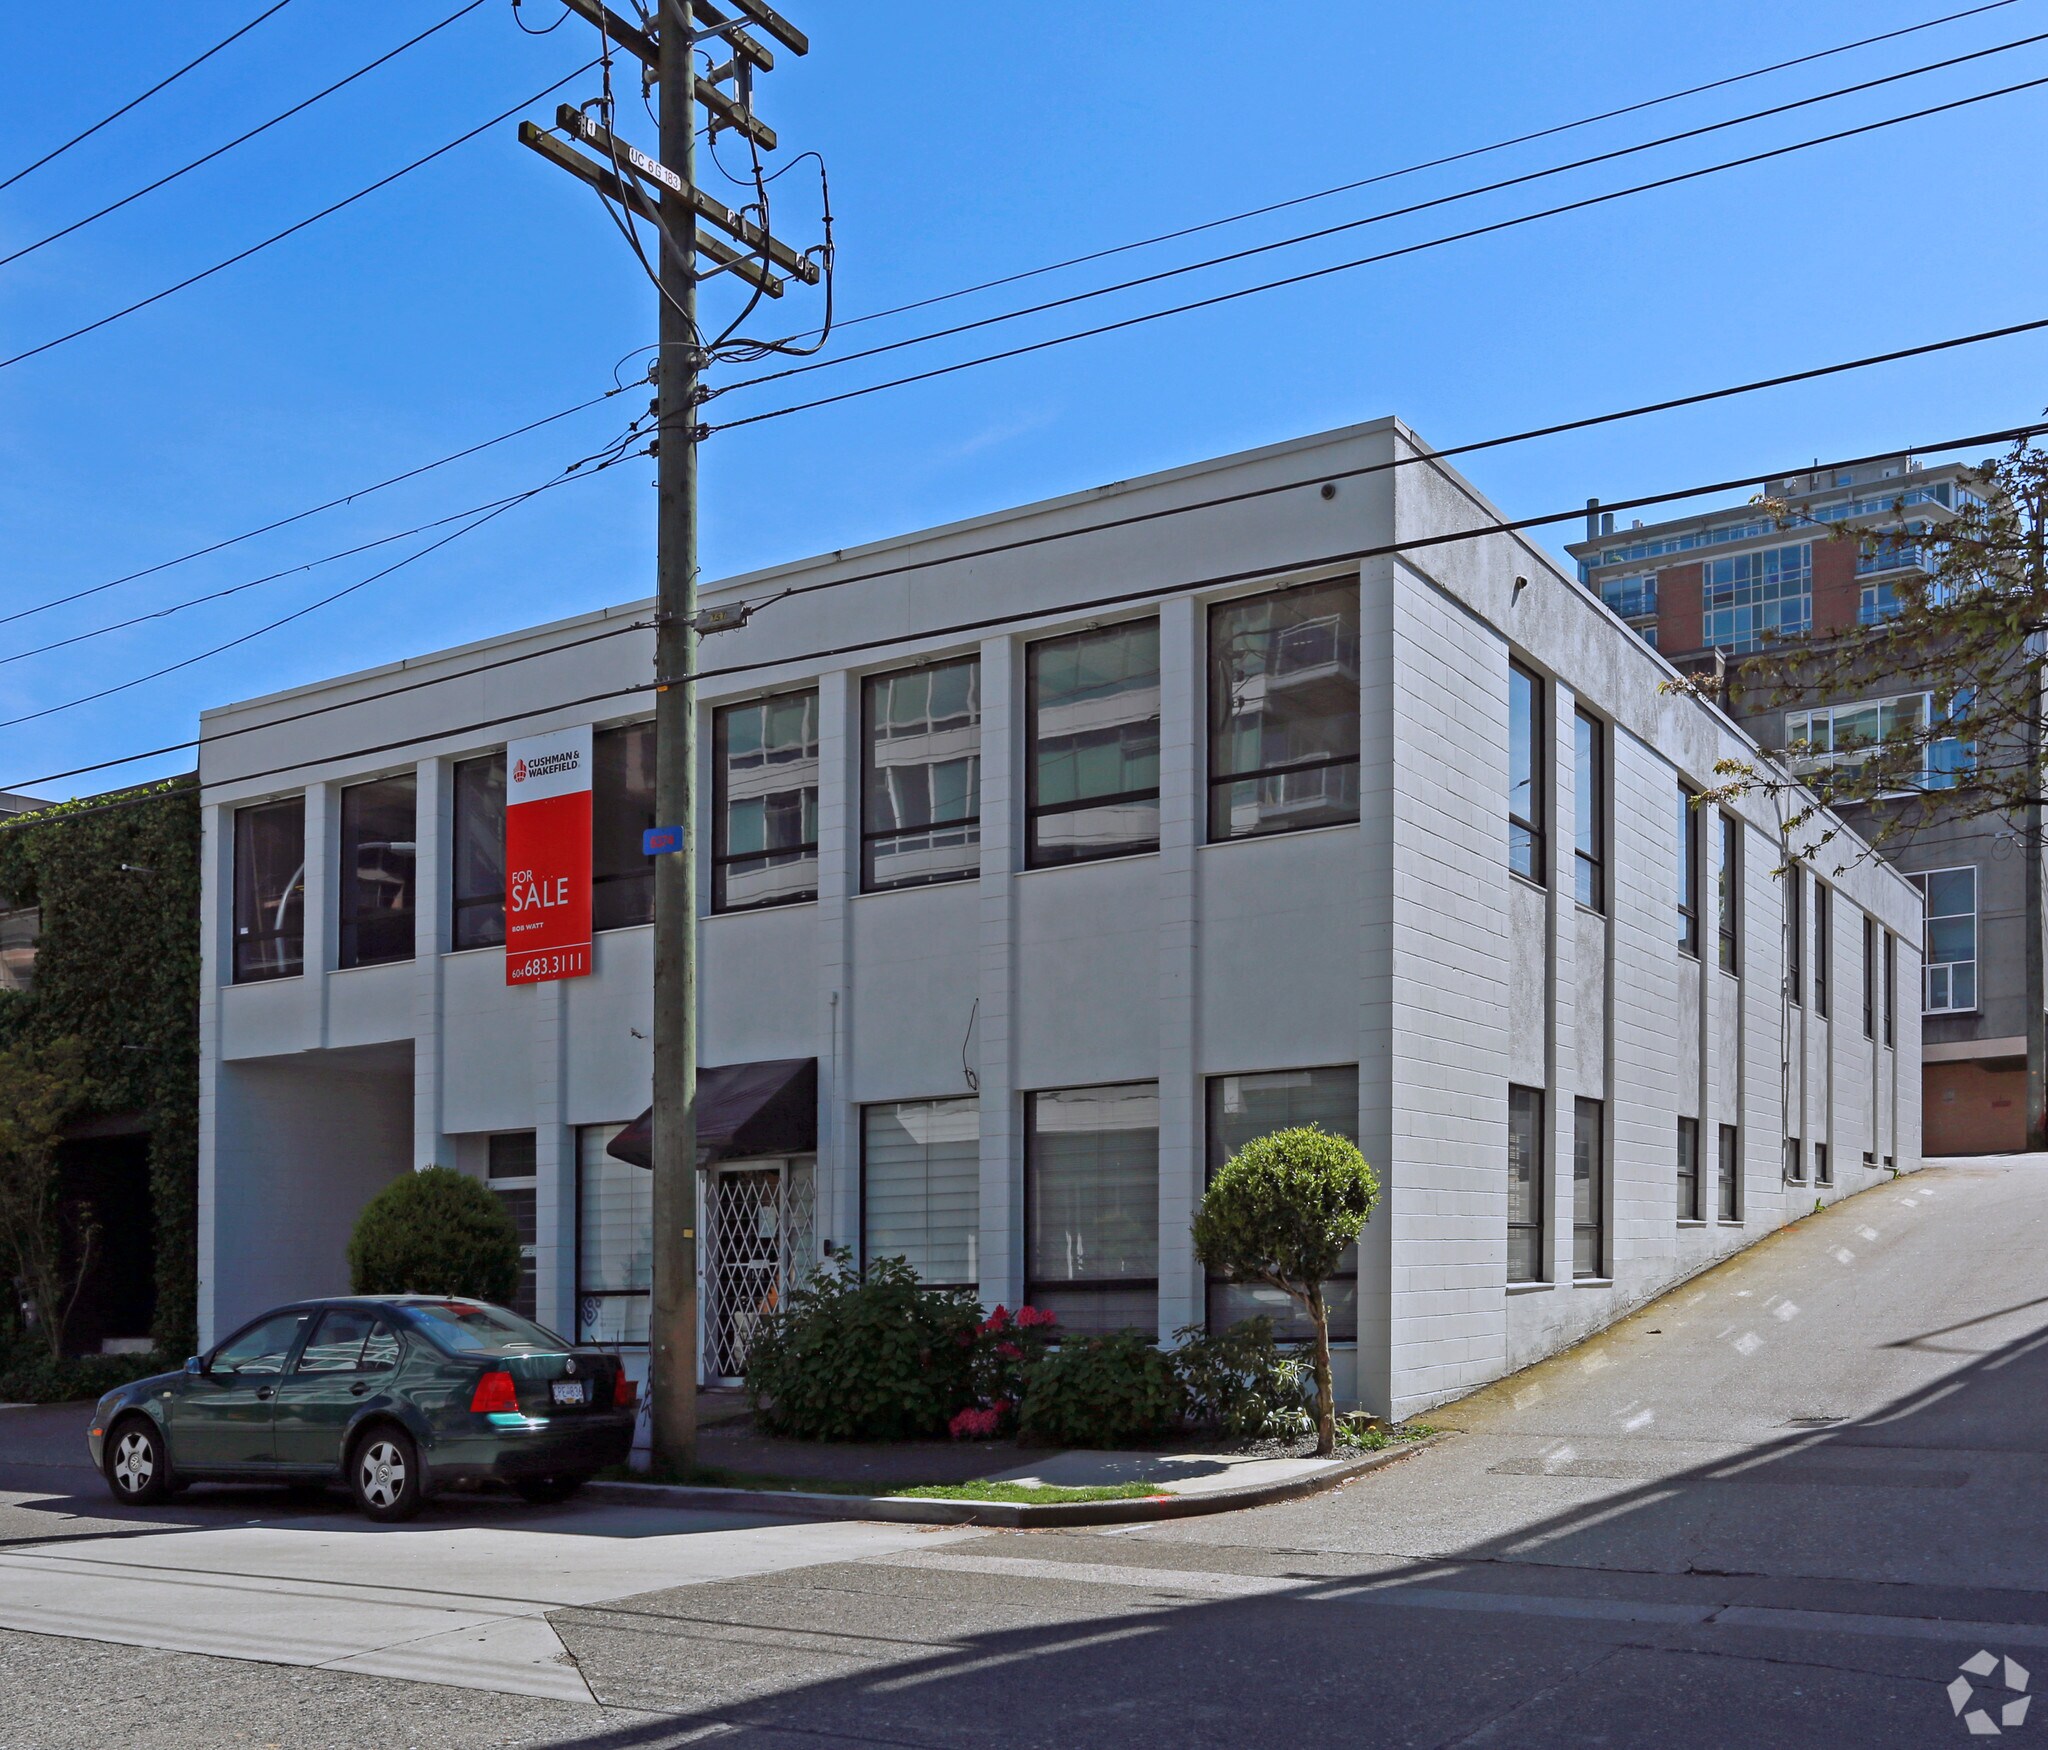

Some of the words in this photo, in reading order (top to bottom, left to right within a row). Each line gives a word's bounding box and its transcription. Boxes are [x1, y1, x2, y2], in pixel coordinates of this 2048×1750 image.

[631, 149, 644, 167] UC
[664, 171, 679, 188] 183
[528, 751, 573, 768] CUSHMAN
[573, 750, 580, 759] &
[528, 760, 578, 778] WAKEFIELD
[512, 870, 533, 884] FOR
[512, 877, 569, 912] SALE
[526, 922, 544, 930] WATT
